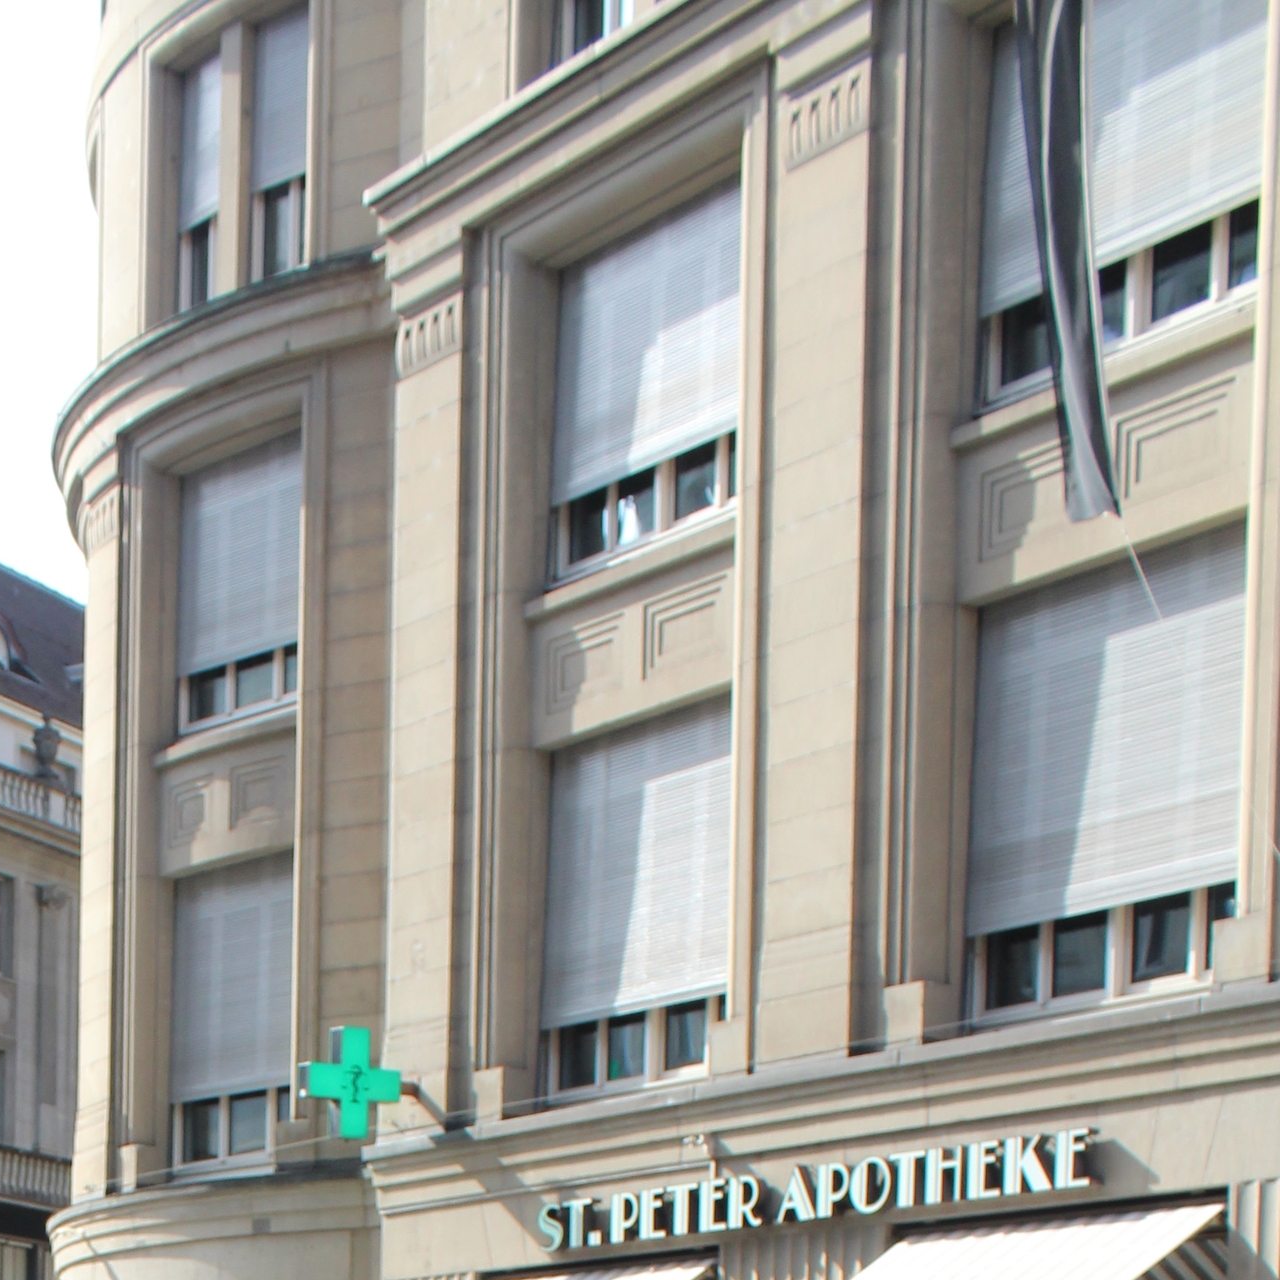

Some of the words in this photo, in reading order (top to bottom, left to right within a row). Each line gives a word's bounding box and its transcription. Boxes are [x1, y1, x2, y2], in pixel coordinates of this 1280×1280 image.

[538, 1197, 603, 1253] ST.
[609, 1174, 763, 1245] PETER
[775, 1127, 1091, 1224] APOTHEKE
